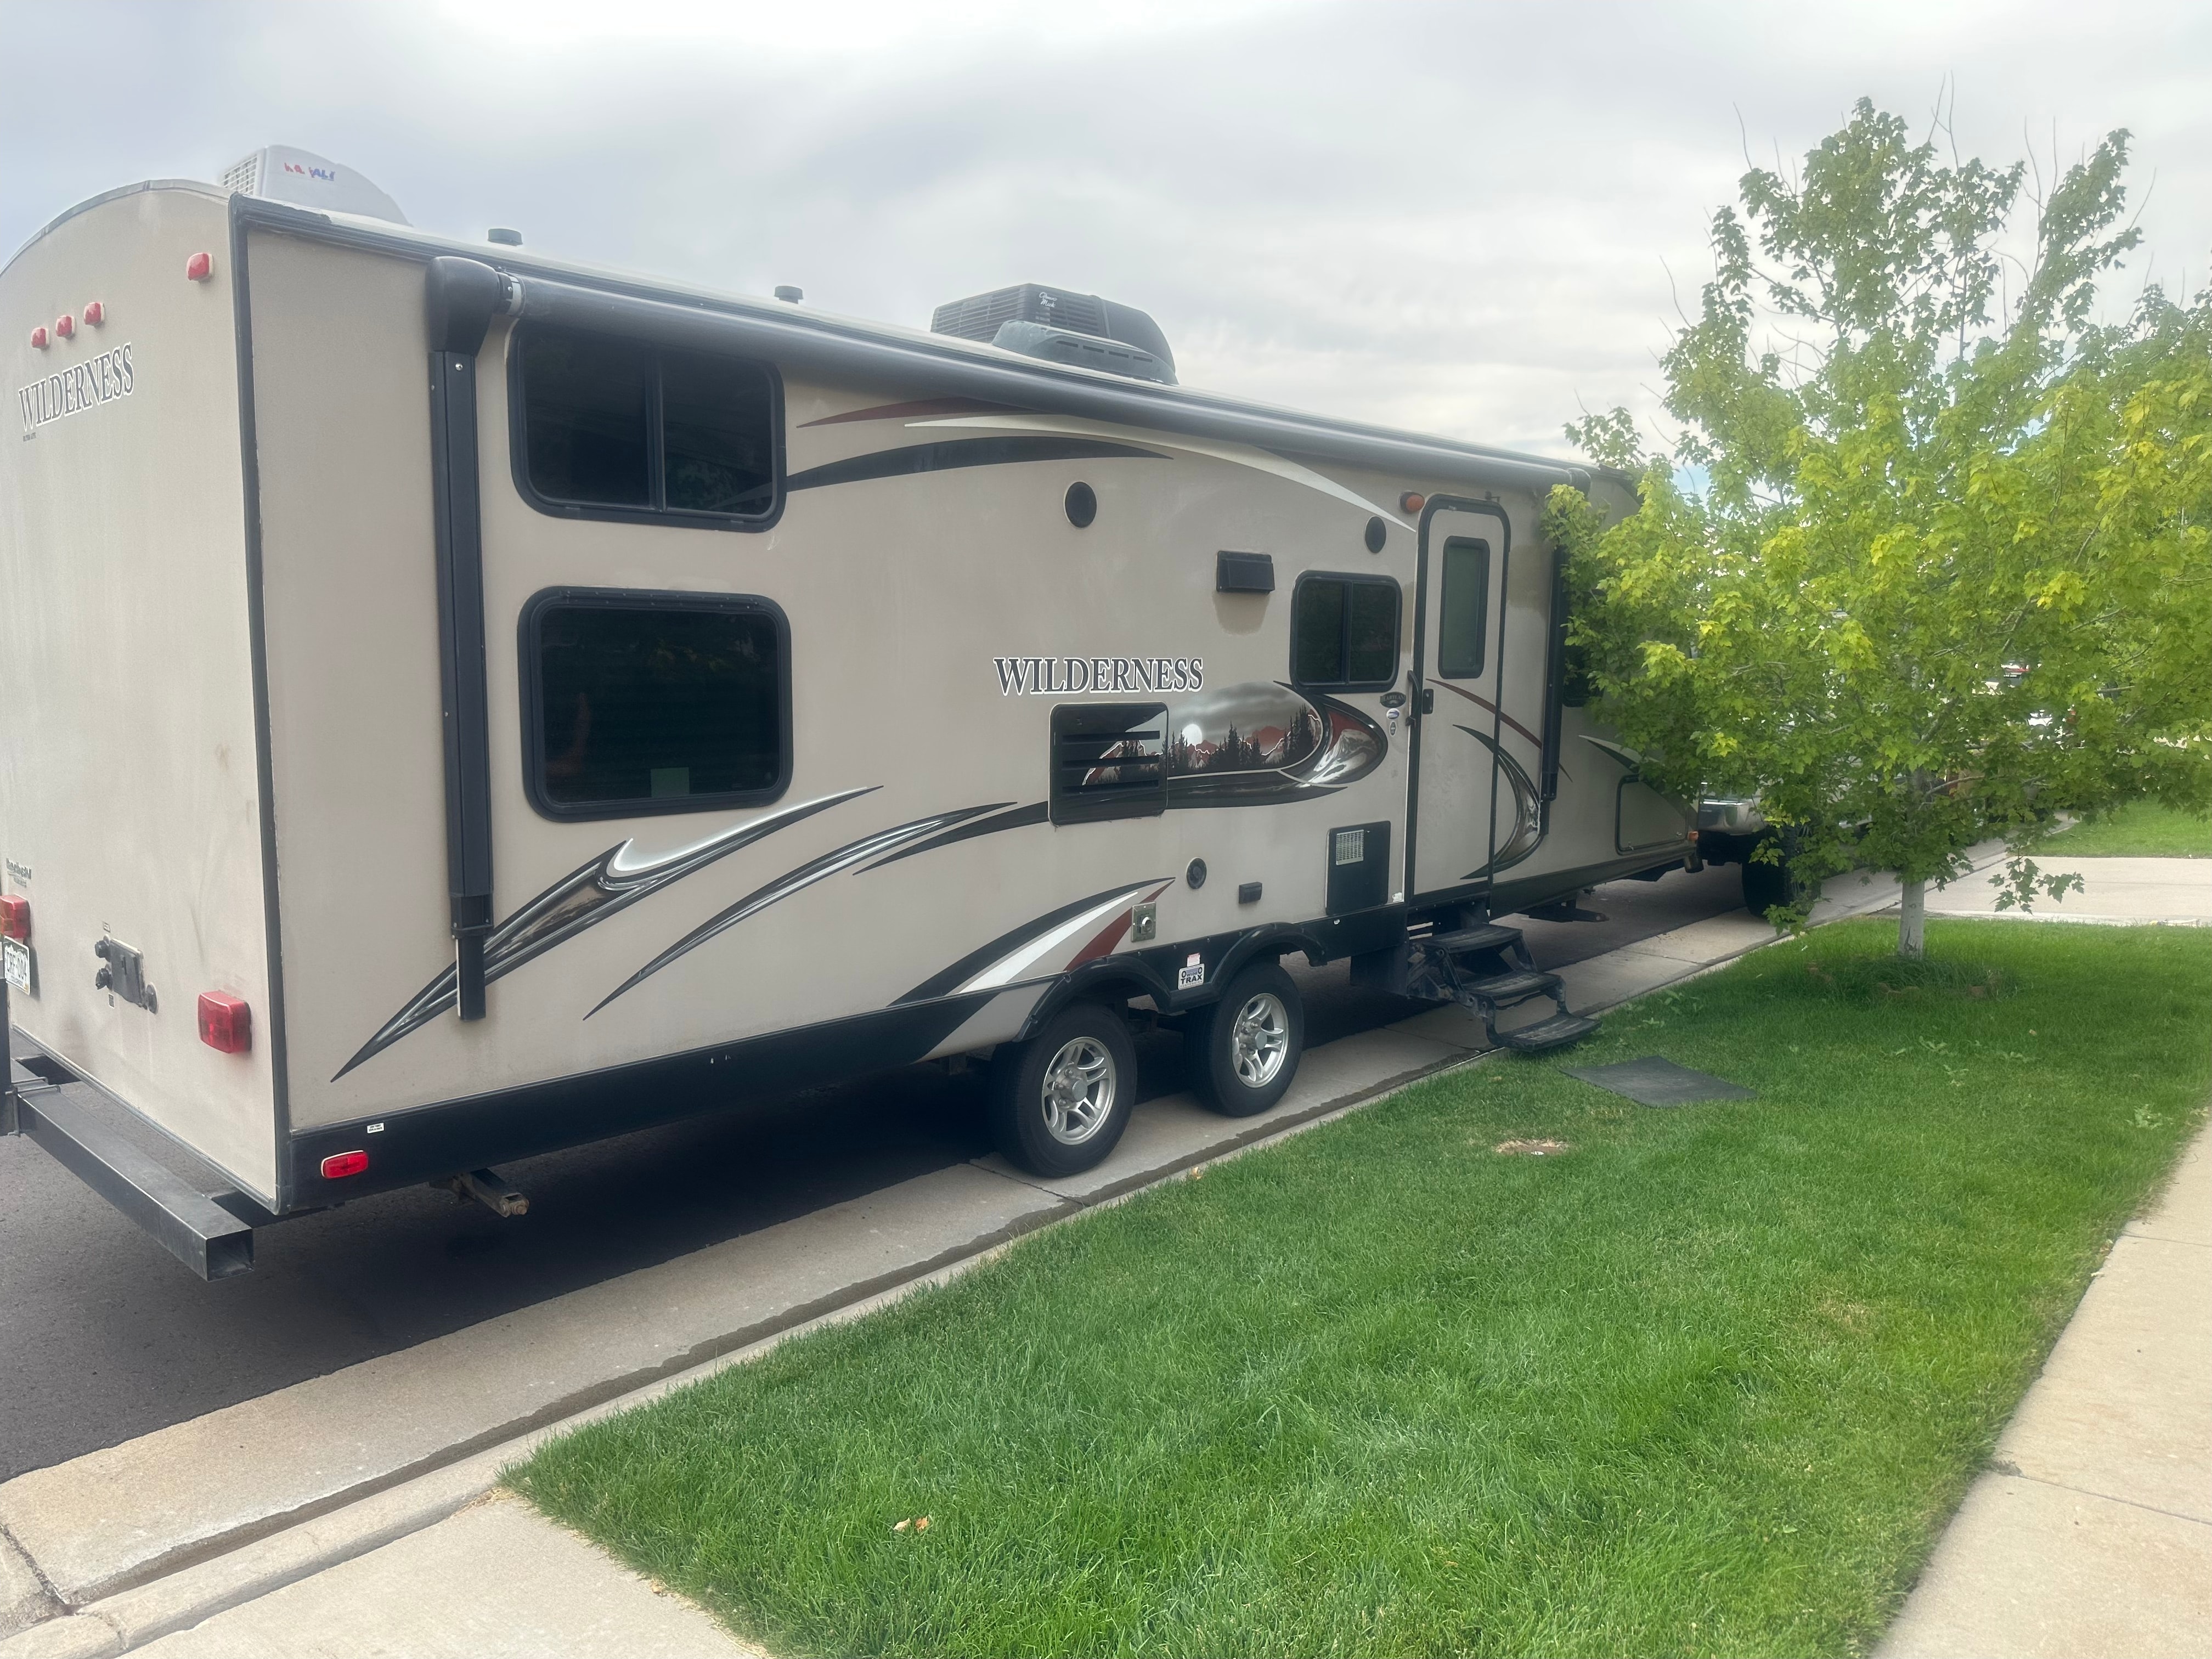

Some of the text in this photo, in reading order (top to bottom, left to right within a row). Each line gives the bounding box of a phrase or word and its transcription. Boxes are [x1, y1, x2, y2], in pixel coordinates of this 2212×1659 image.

[19, 342, 134, 432] WILDERNESS
[994, 658, 1203, 696] WILDERNESS
[1181, 974, 1203, 984] TRAX
